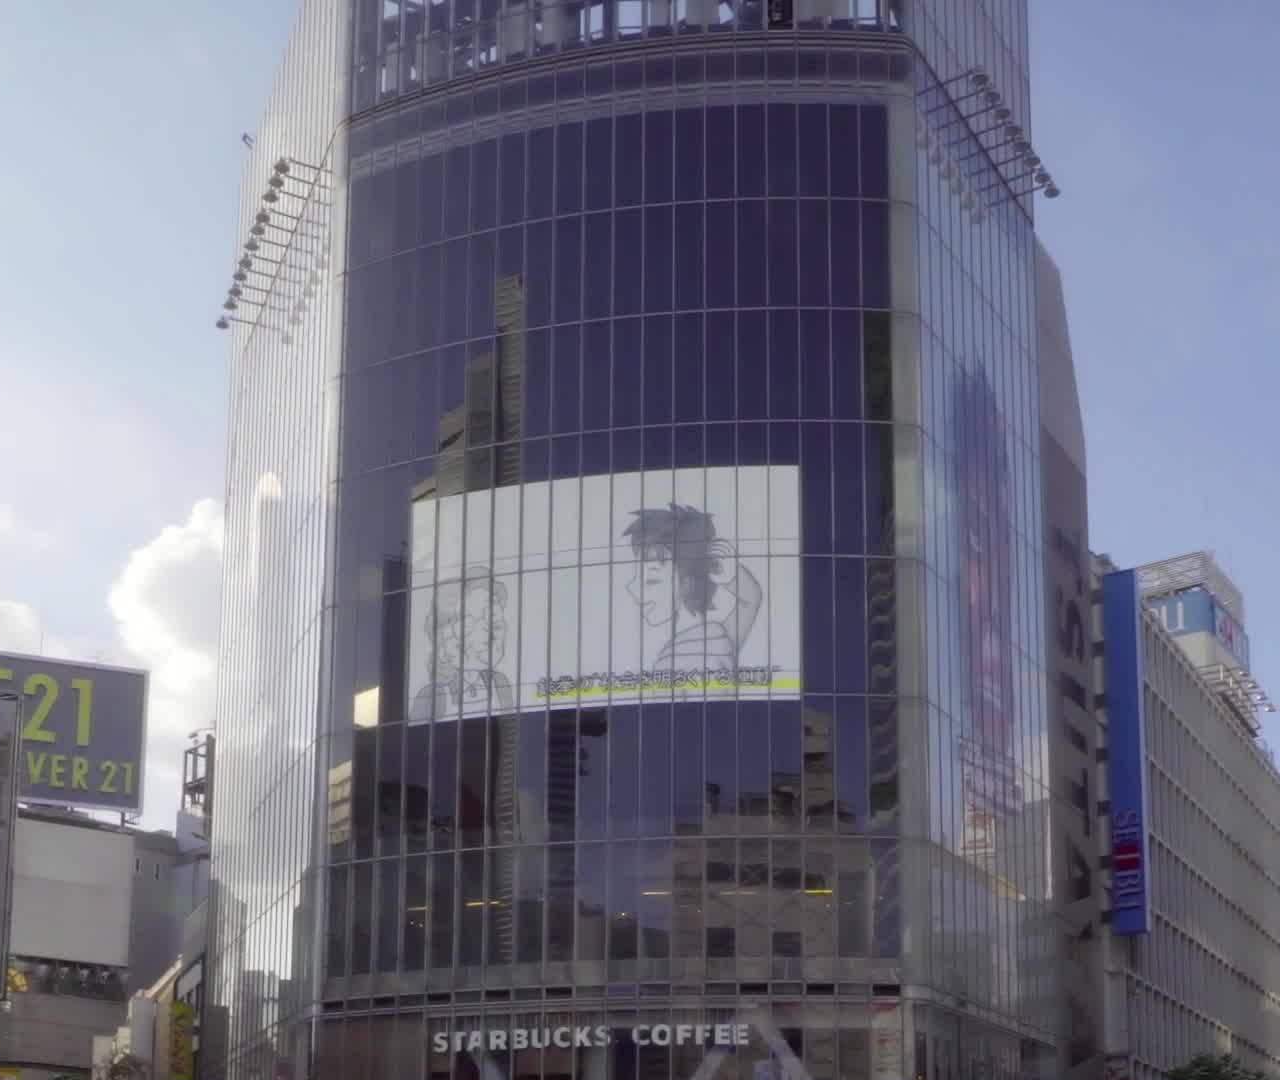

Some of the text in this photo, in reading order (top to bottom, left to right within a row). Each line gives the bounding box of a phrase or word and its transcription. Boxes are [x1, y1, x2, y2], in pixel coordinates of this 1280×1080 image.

[100, 759, 135, 795] 21
[433, 1023, 752, 1055] STARBUCKS COFFEE
